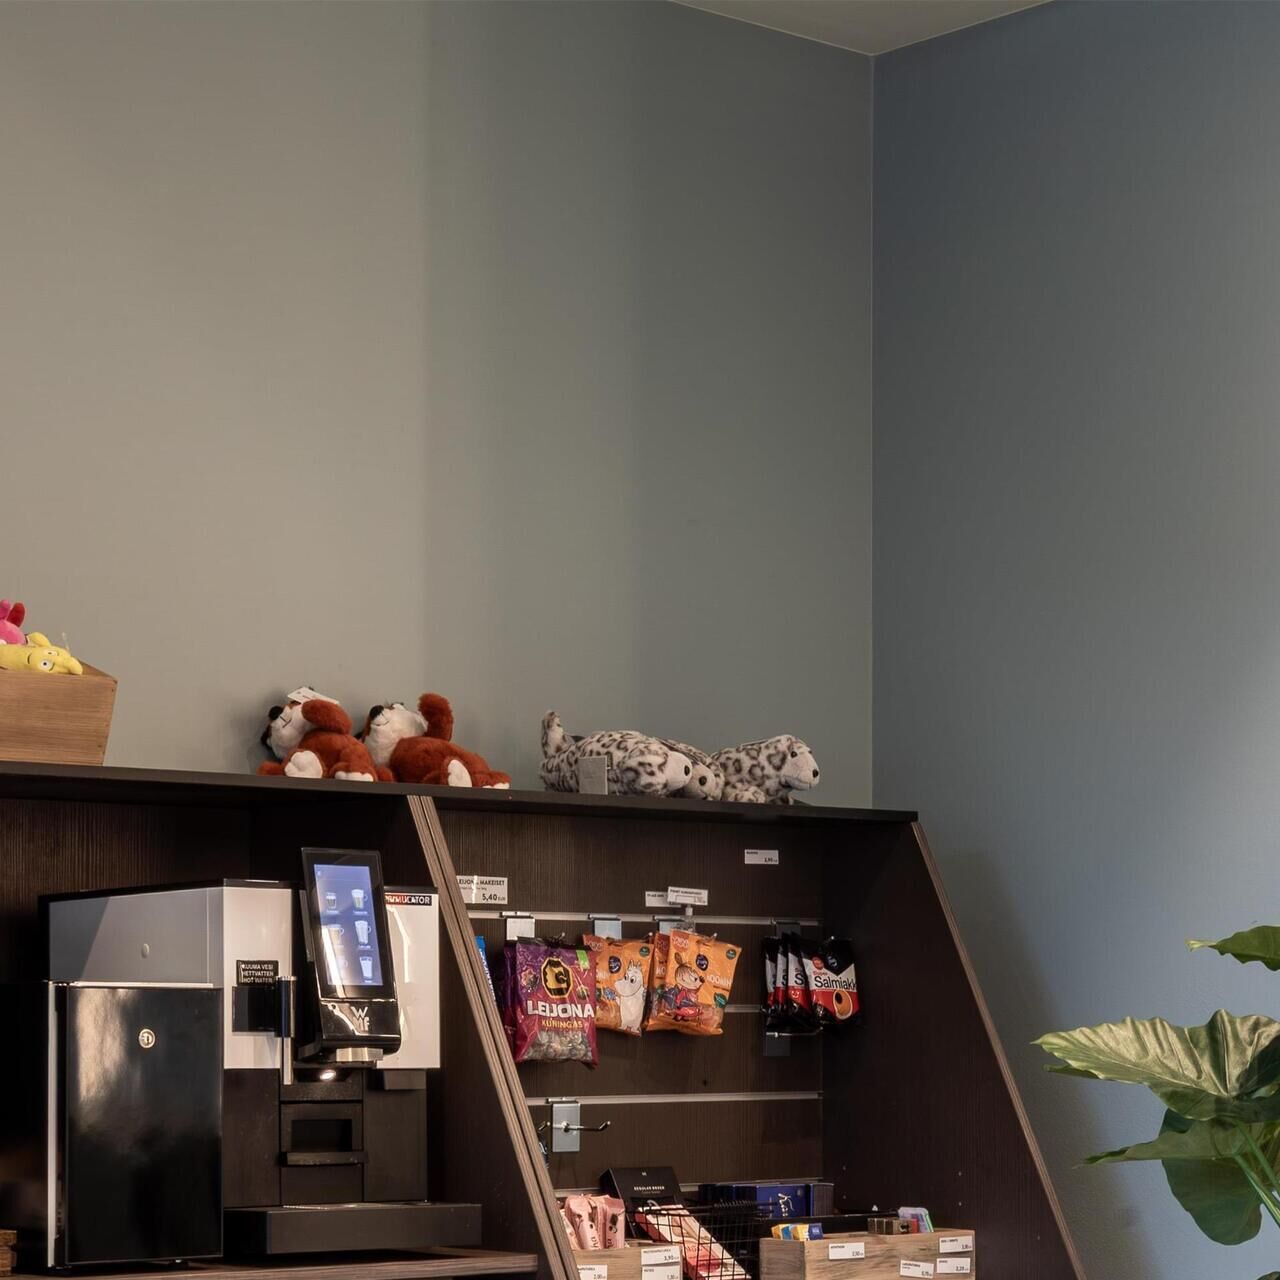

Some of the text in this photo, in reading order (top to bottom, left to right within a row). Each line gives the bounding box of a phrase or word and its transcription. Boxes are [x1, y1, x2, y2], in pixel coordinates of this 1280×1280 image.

[482, 893, 498, 902] 5,40
[527, 1000, 595, 1018] LEIJONA
[541, 1018, 584, 1029] KUNINGAS
